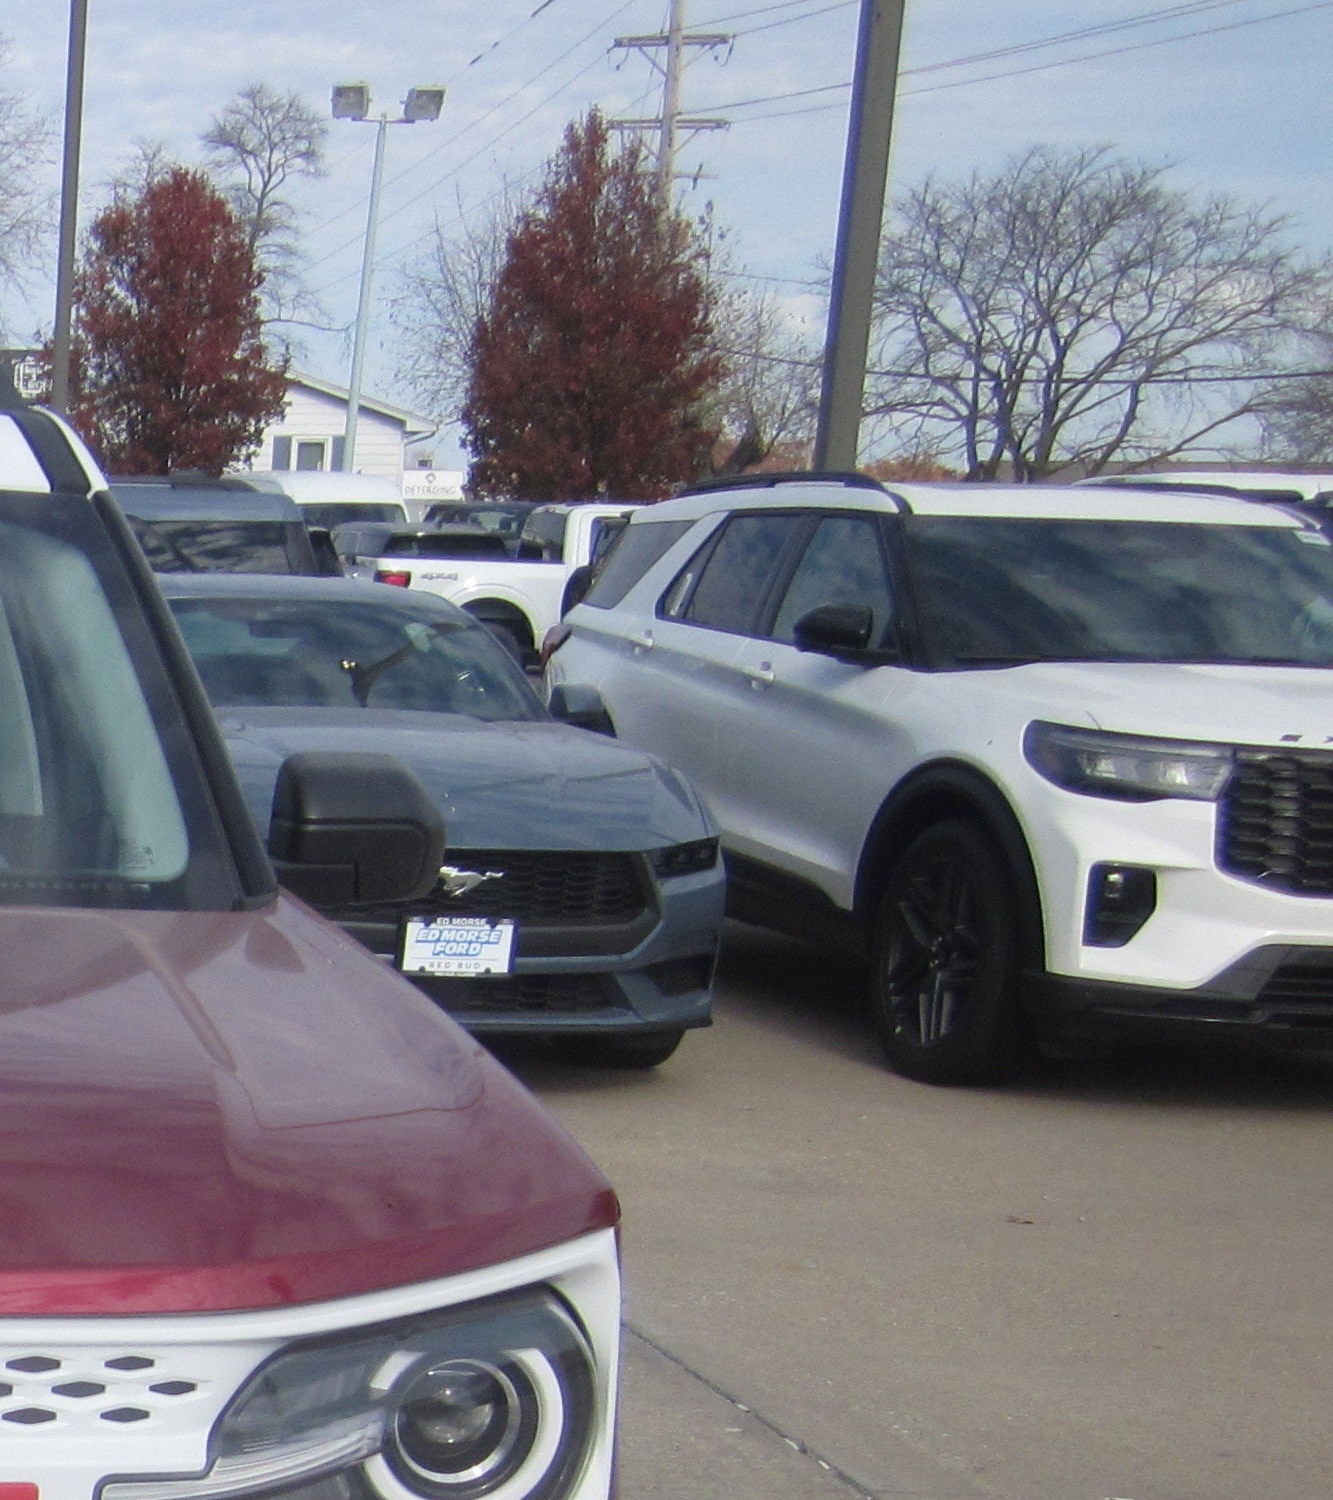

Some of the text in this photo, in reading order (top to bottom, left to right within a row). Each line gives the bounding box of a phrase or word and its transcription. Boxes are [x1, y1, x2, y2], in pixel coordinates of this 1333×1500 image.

[436, 917, 488, 927] ED MORSE
[416, 928, 503, 944] ED MORSE
[433, 941, 482, 957] FORD
[429, 961, 481, 970] RED BUD
